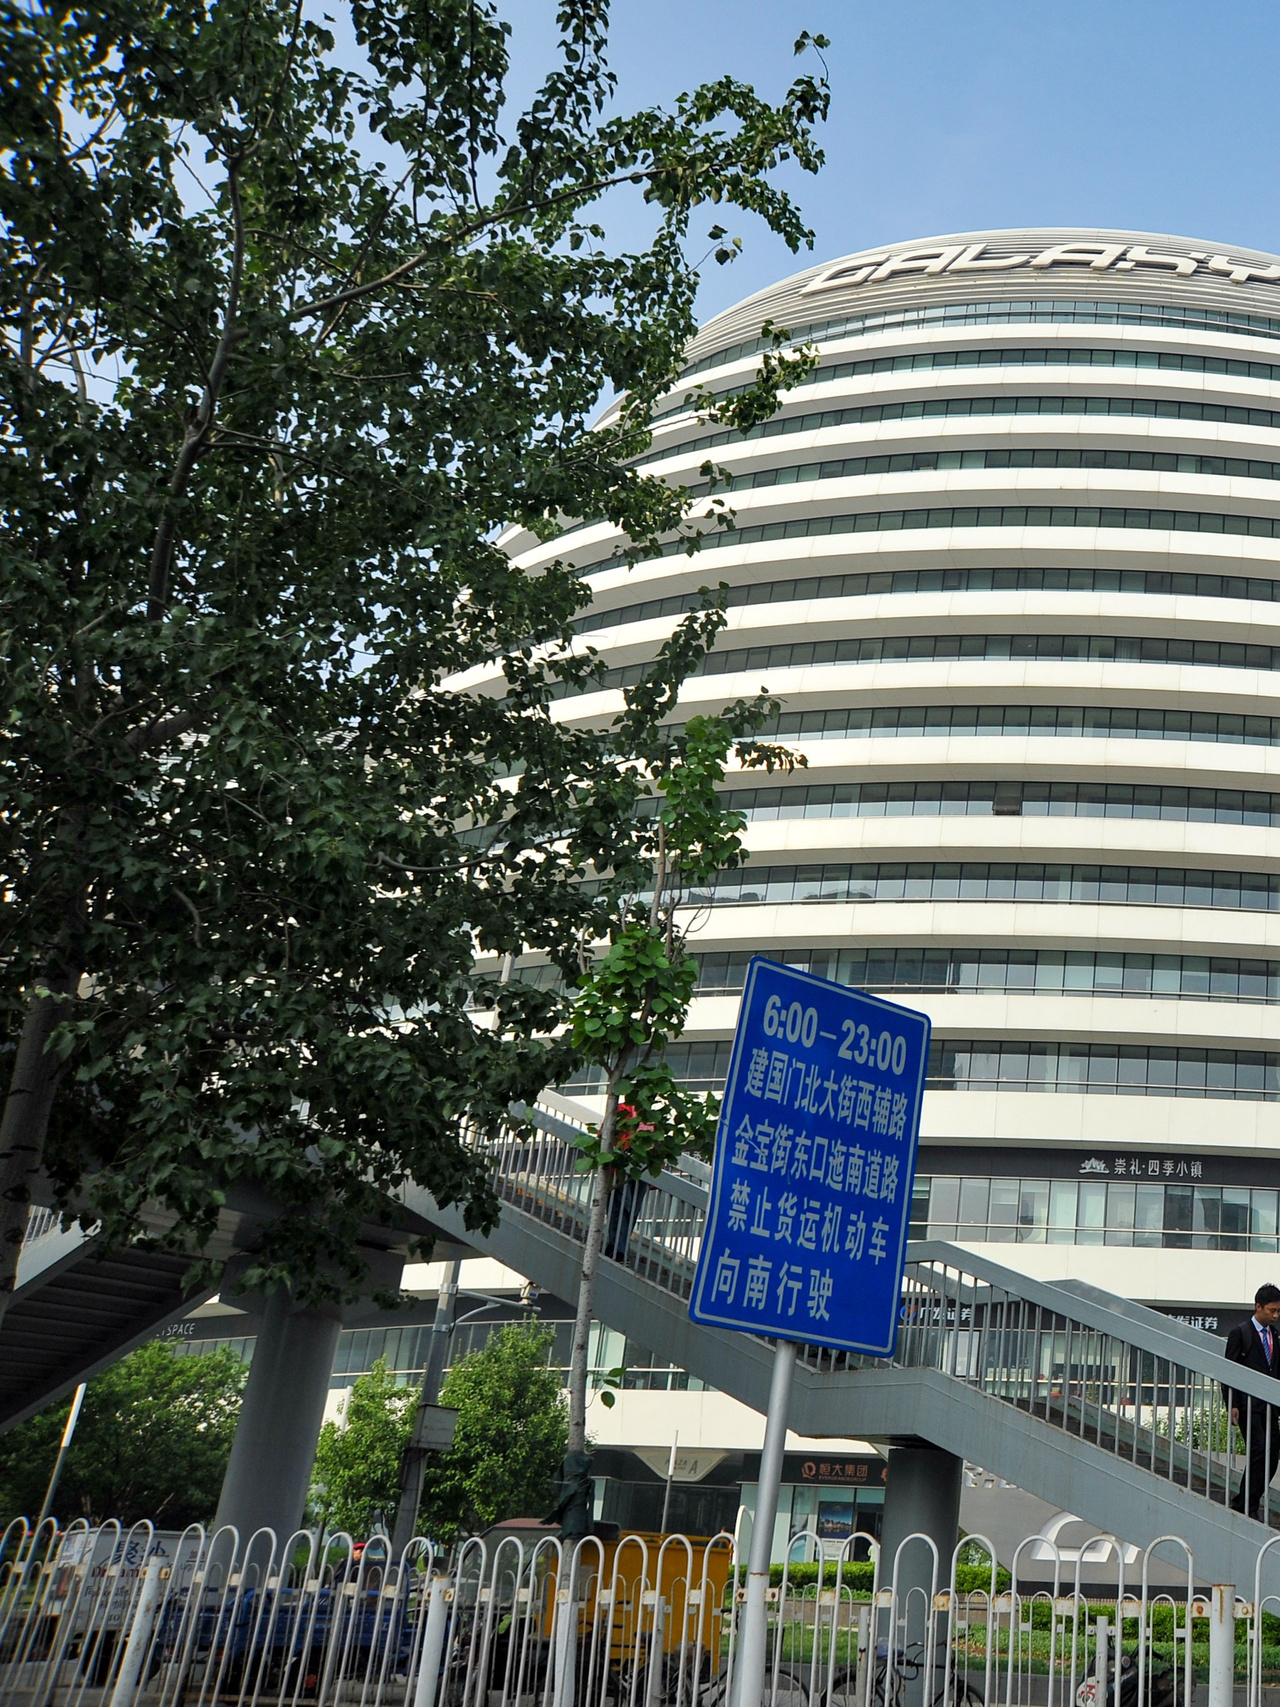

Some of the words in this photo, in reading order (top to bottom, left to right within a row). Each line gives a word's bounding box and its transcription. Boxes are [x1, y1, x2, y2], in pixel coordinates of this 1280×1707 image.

[744, 1047, 907, 1141] 建国门北大街西辅路
[731, 1114, 899, 1204] 金宝街东口迤南道路
[727, 1178, 889, 1265] 禁止货运机动车
[711, 1248, 833, 1321] 向南行驶
[819, 1463, 868, 1477] 恒大集团
